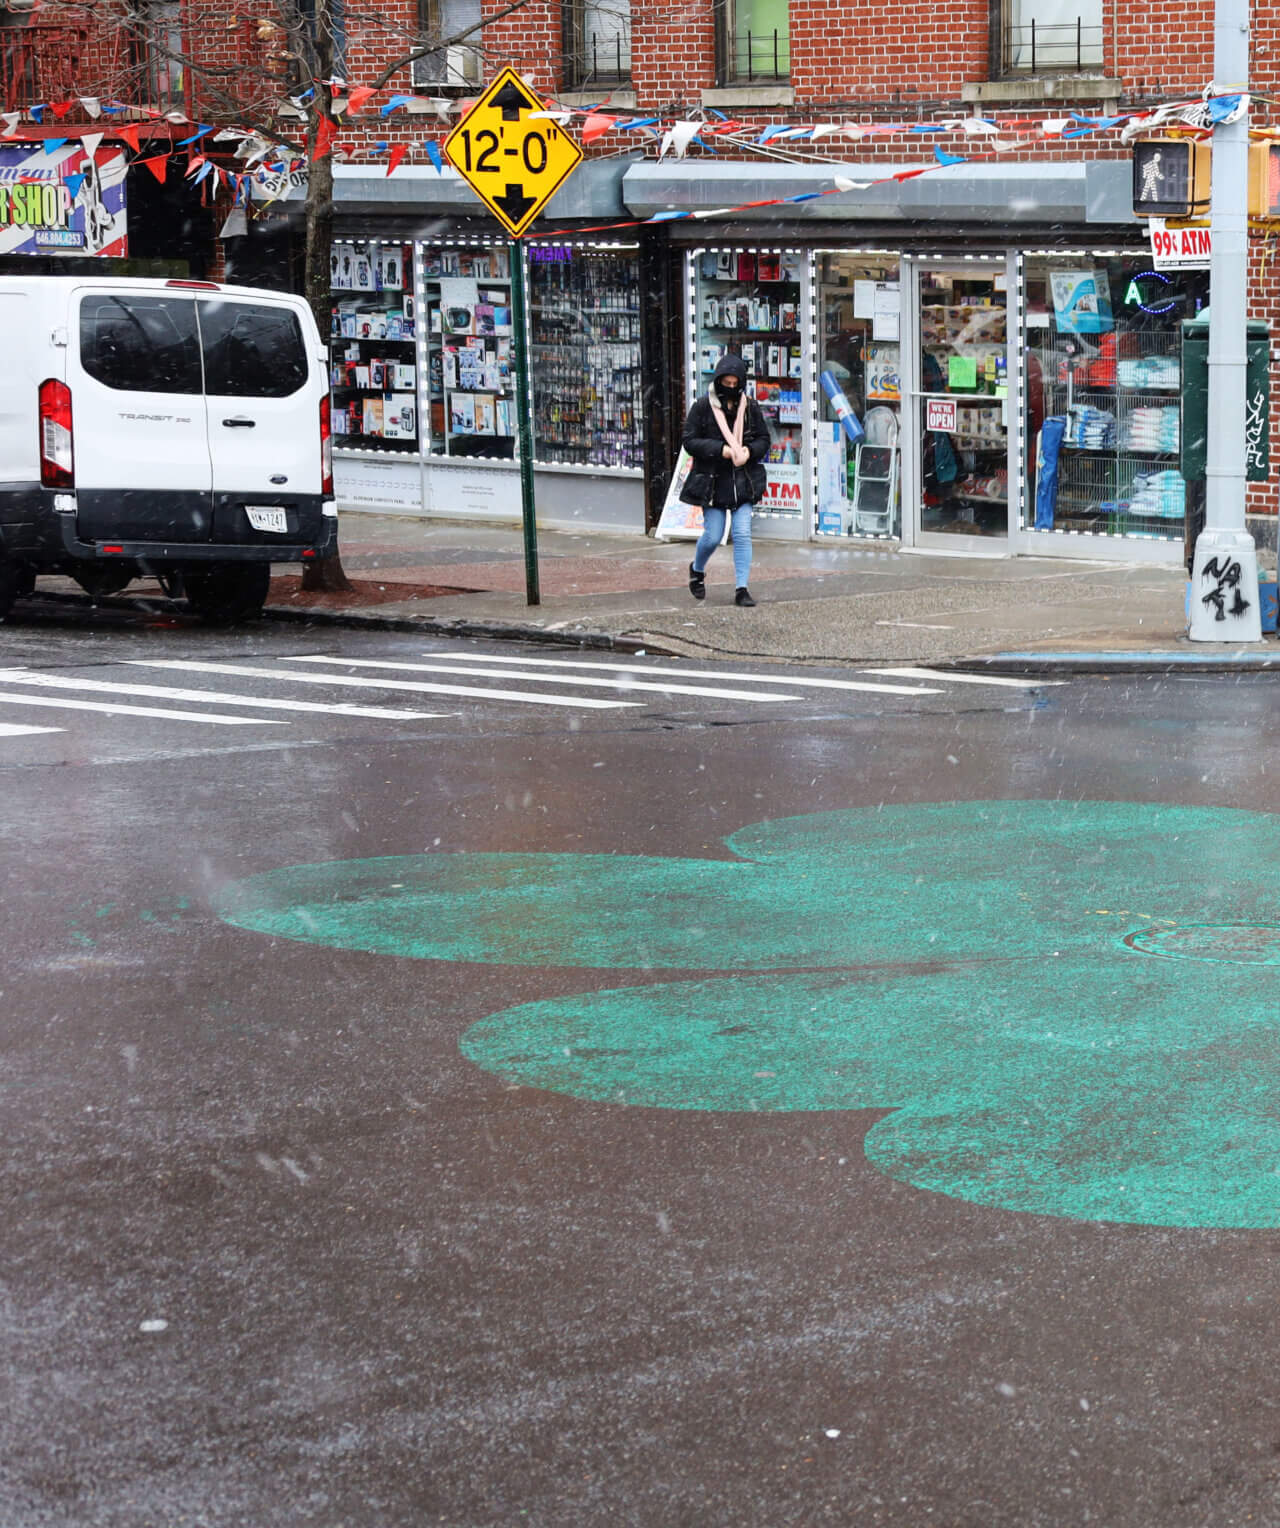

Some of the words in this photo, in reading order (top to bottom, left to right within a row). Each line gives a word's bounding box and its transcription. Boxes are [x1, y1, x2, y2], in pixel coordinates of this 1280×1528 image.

[12, 183, 72, 226] SHOP
[1181, 230, 1211, 256] ATM
[117, 412, 174, 422] TRANSIT
[929, 413, 954, 428] OPEN
